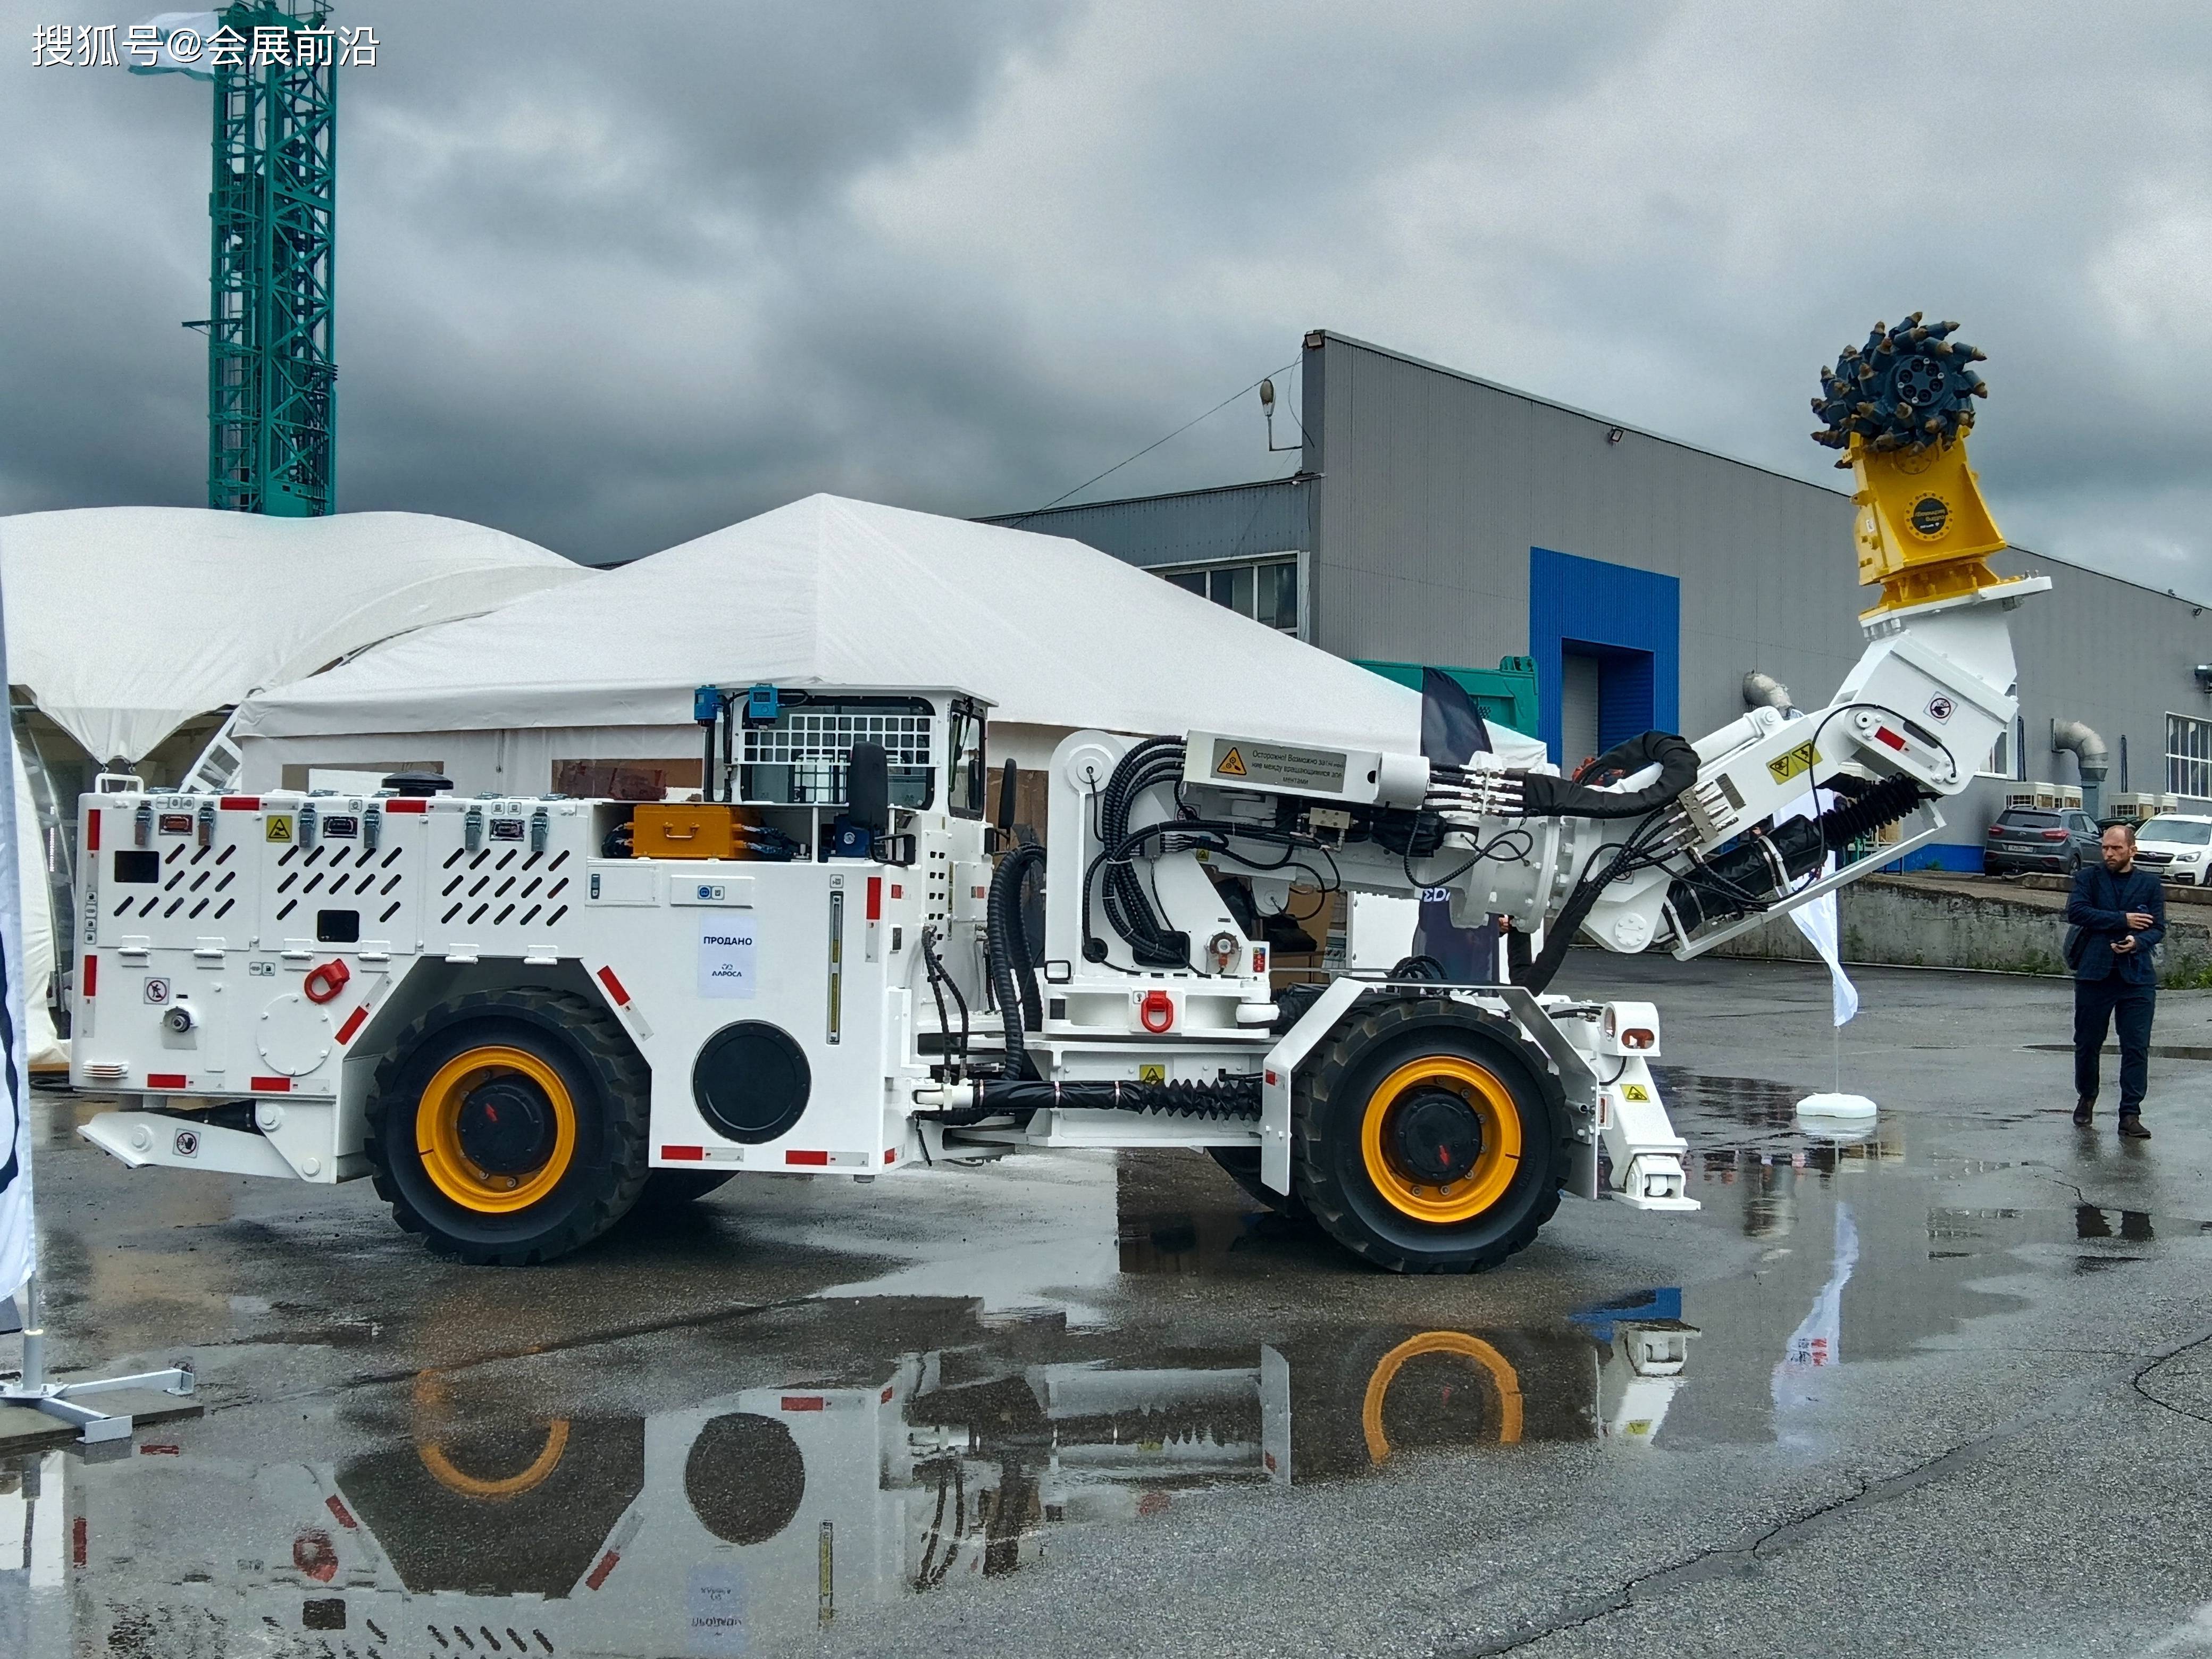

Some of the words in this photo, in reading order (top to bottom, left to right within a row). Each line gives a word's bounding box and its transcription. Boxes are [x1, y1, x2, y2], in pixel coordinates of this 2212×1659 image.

[1253, 750, 1286, 760] Осторожно!
[1288, 754, 1317, 765] Возможно
[1263, 764, 1283, 773] между
[703, 936, 752, 945] ПРОДАНО
